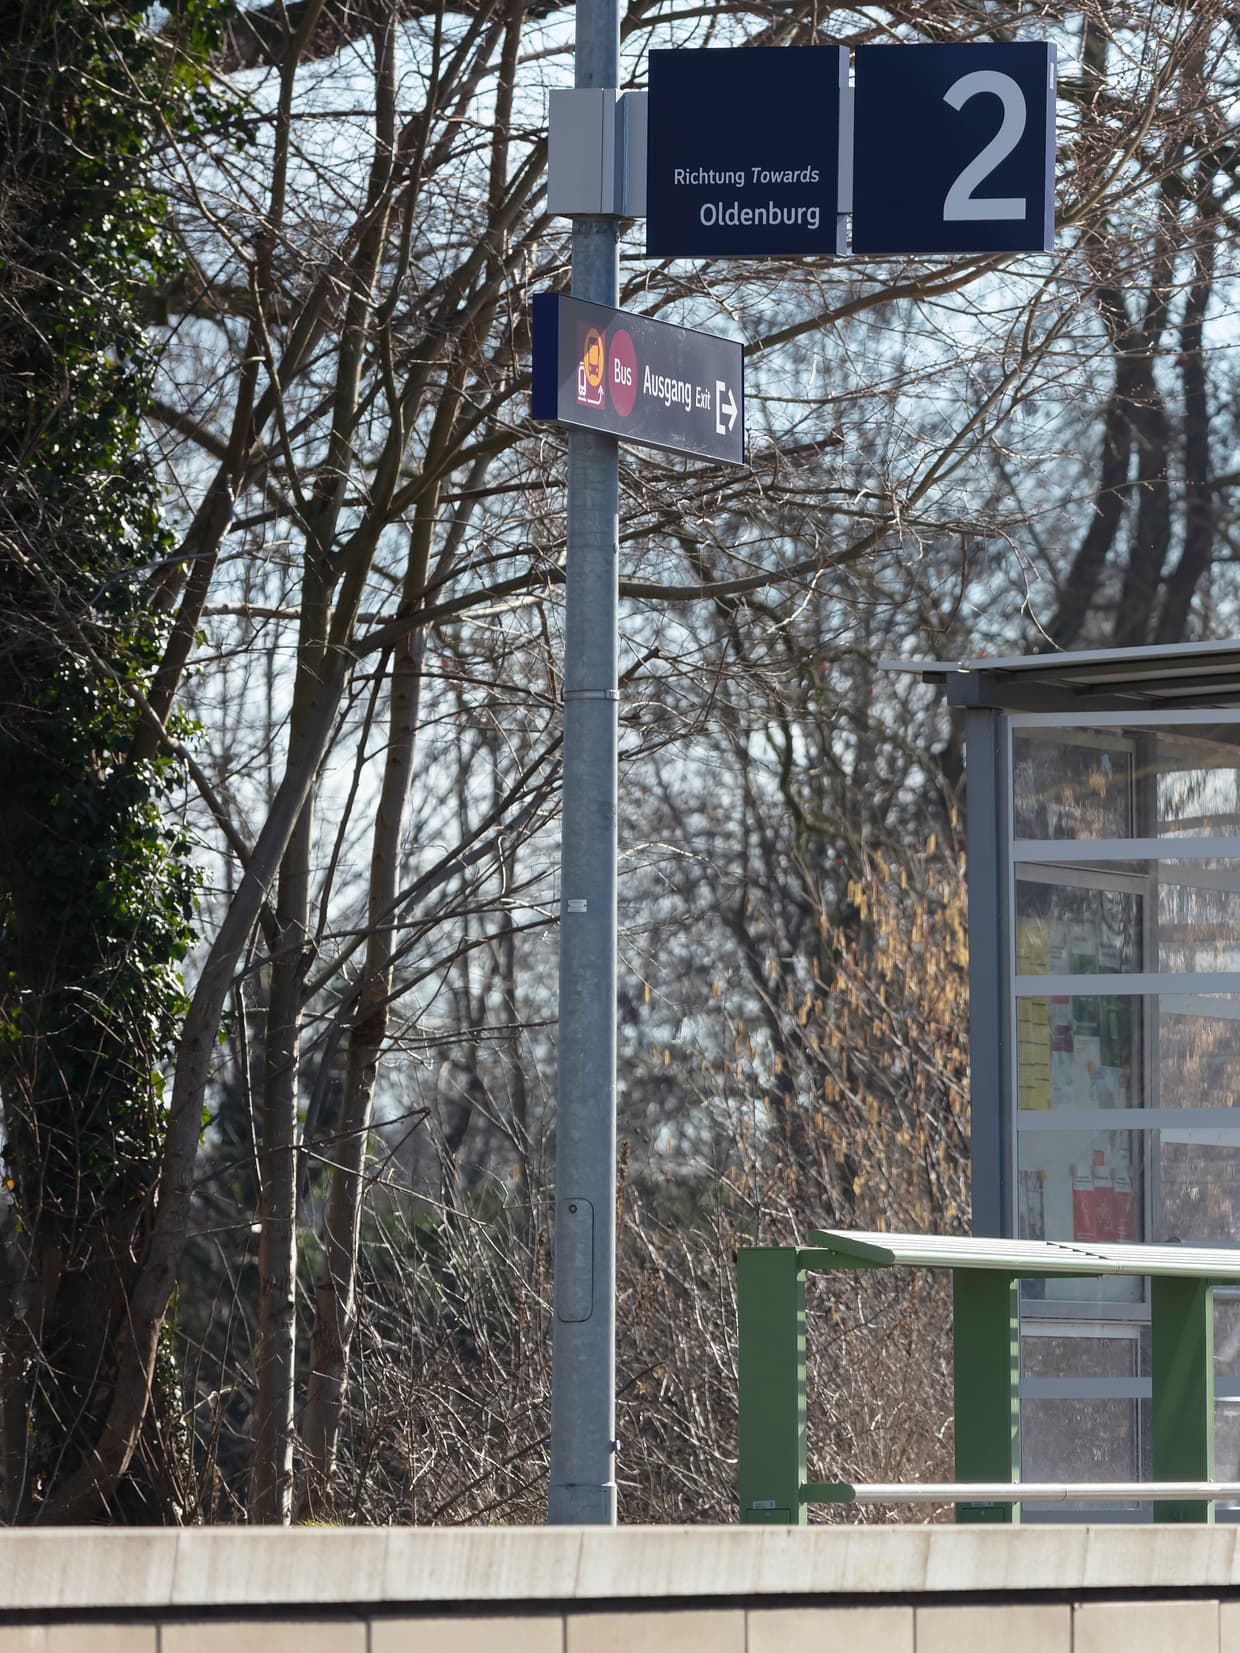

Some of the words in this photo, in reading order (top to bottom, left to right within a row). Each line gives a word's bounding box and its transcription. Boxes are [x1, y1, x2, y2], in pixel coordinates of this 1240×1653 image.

[943, 70, 1027, 221] 2
[674, 167, 745, 187] Richtung
[751, 165, 820, 183] Towards
[700, 201, 820, 229] Oldenburg
[614, 357, 632, 386] Bus
[643, 364, 692, 412] Ausgang
[695, 386, 711, 411] Exit
